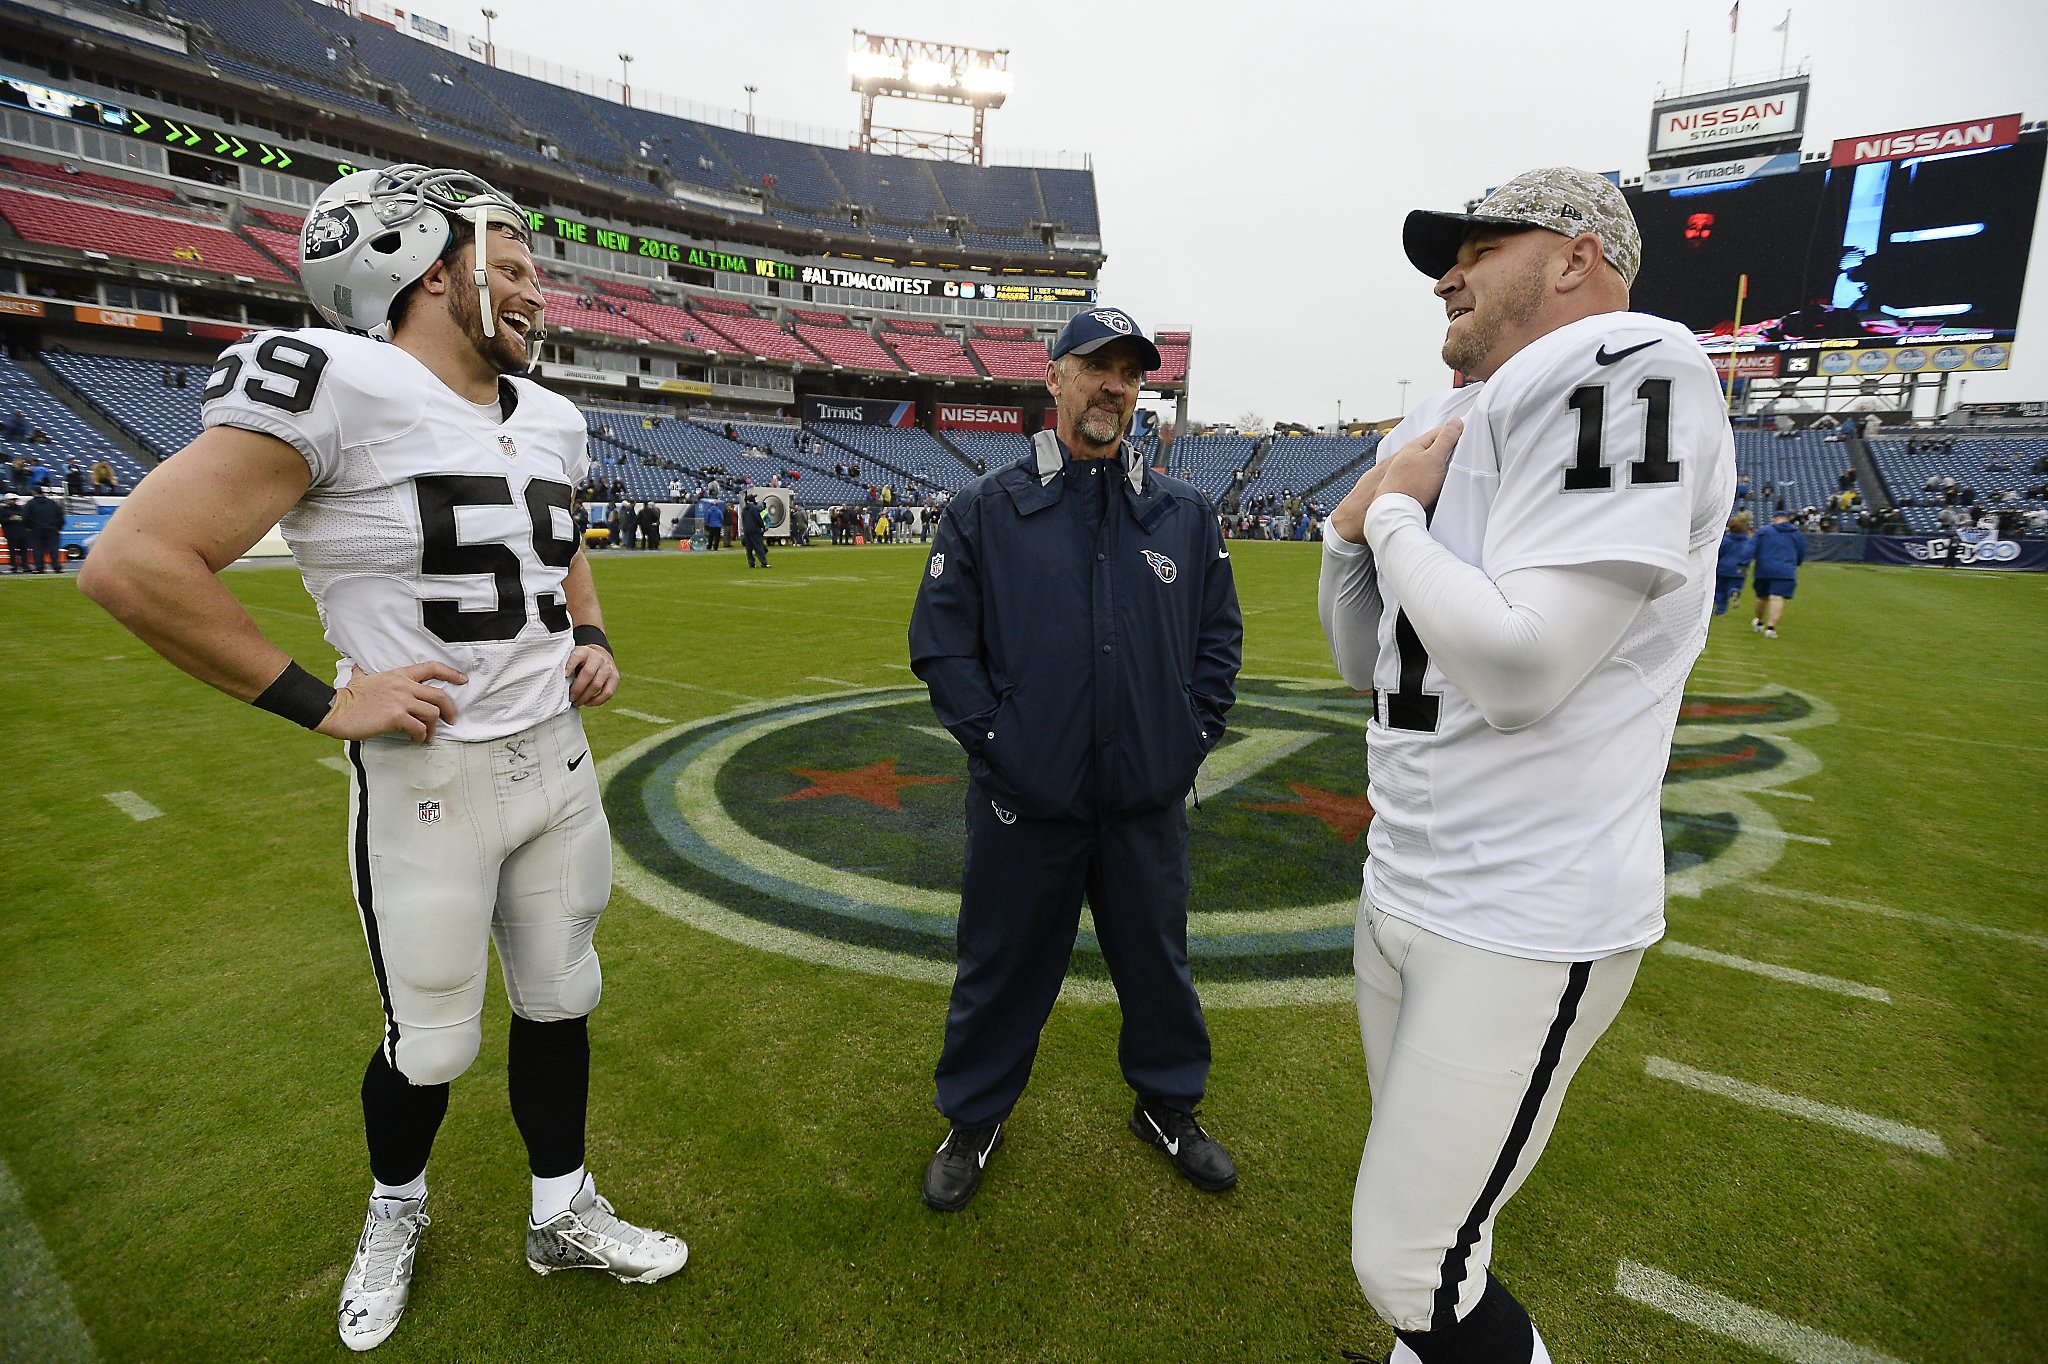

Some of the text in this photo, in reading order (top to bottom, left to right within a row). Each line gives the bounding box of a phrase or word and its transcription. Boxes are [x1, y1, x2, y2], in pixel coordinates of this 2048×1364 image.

[1669, 98, 1786, 133] NISSAN
[1689, 122, 1760, 142] STADIUM
[1854, 122, 1995, 162] NISSAN
[1686, 163, 1746, 181] Pinnacle
[554, 217, 588, 244] THE
[596, 229, 630, 252] NEW
[638, 238, 681, 262] 2016
[688, 248, 749, 274] ALTIMA
[755, 258, 795, 280] WITH
[802, 265, 932, 296] #ALTIMACONTEST
[201, 330, 330, 414] 59
[816, 402, 863, 421] TITANS
[941, 407, 1019, 425] NISSAN
[1563, 377, 1681, 491] 11
[414, 474, 582, 643] 59
